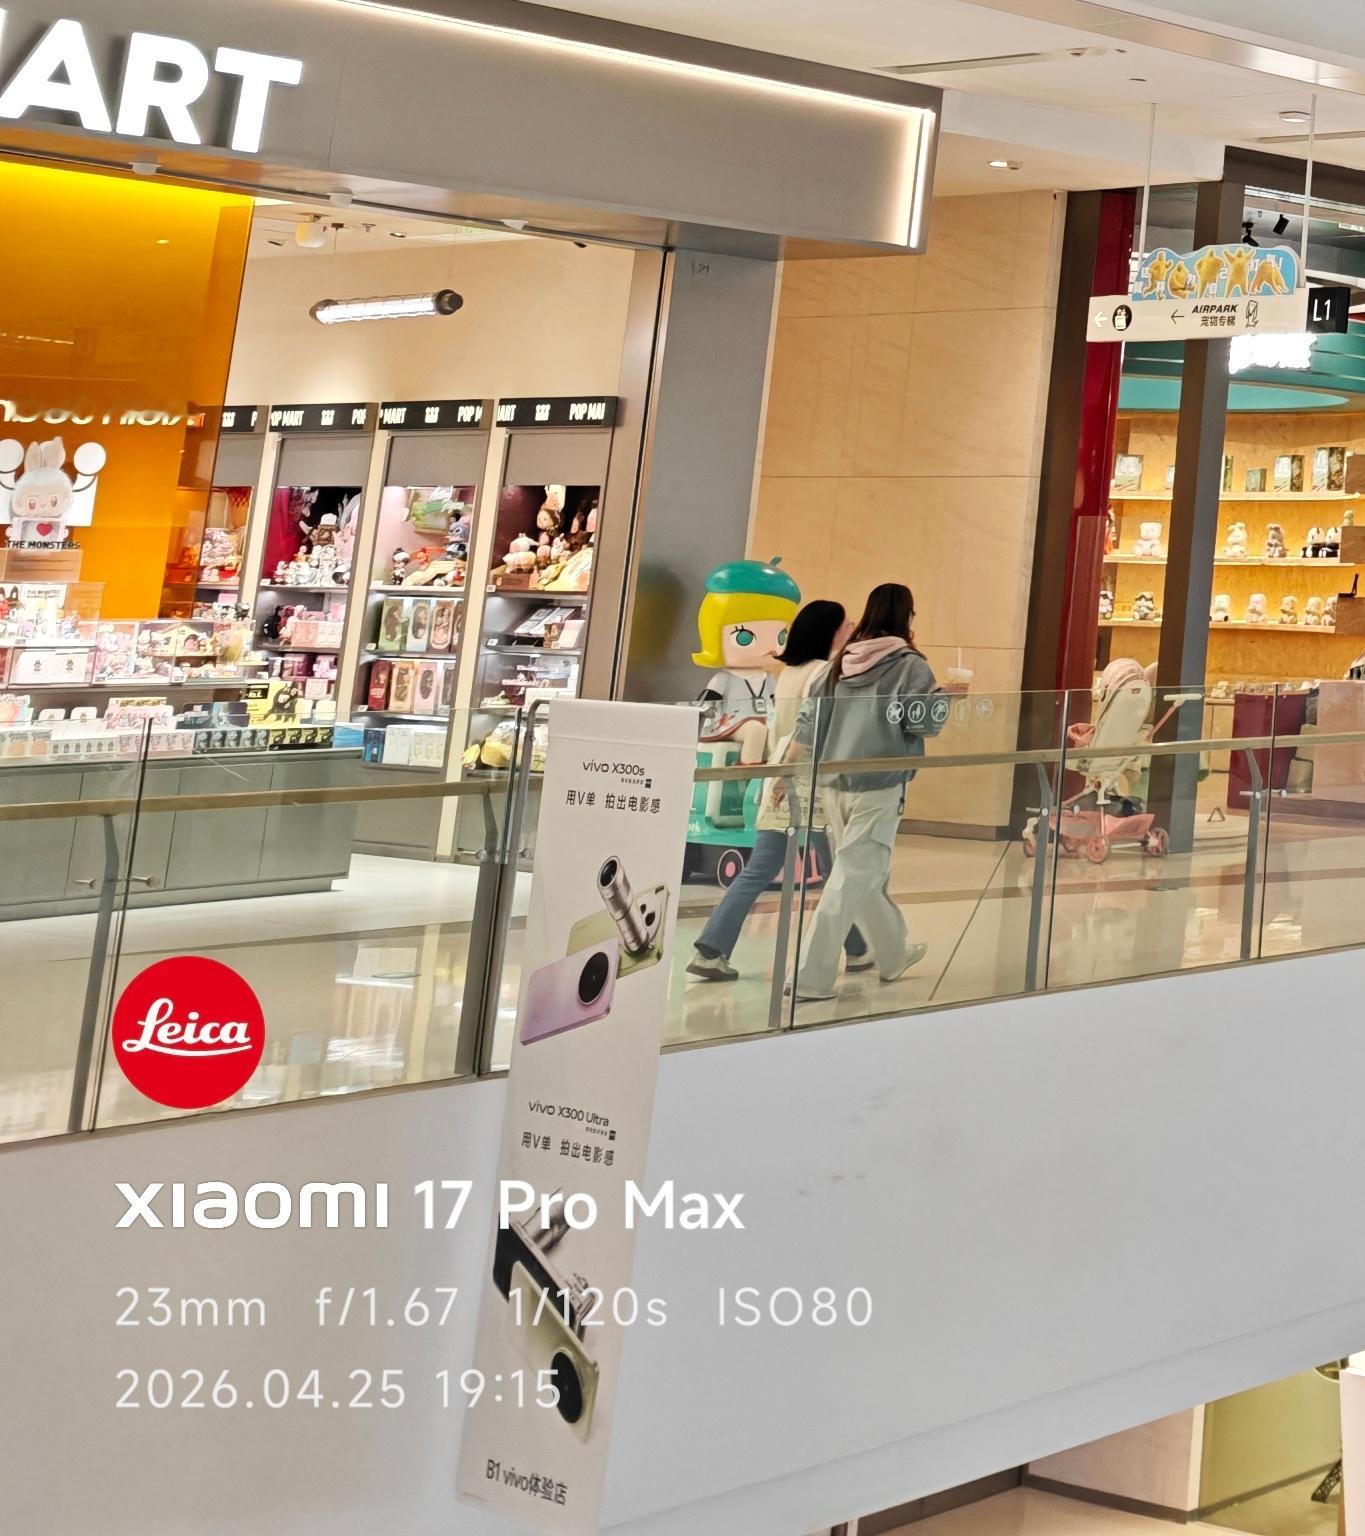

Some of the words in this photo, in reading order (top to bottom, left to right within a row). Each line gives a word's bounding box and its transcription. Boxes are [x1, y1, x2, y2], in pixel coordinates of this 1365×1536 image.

[0, 7, 303, 154] ART
[1192, 304, 1238, 314] AIRPARK
[1312, 298, 1331, 322] L1
[28, 540, 80, 549] MONSTERS
[582, 758, 609, 773] vivo
[611, 762, 645, 776] X300s
[565, 789, 596, 808] 用V单
[605, 792, 661, 814] 拍出电影感
[528, 1099, 555, 1116] vivo
[557, 1104, 584, 1122] X300
[585, 1111, 609, 1127] Ultra
[521, 1131, 552, 1151] 用V单
[559, 1139, 614, 1167] 拍出电影感
[486, 1459, 500, 1480] B1
[502, 1463, 568, 1506] vivo体验店
